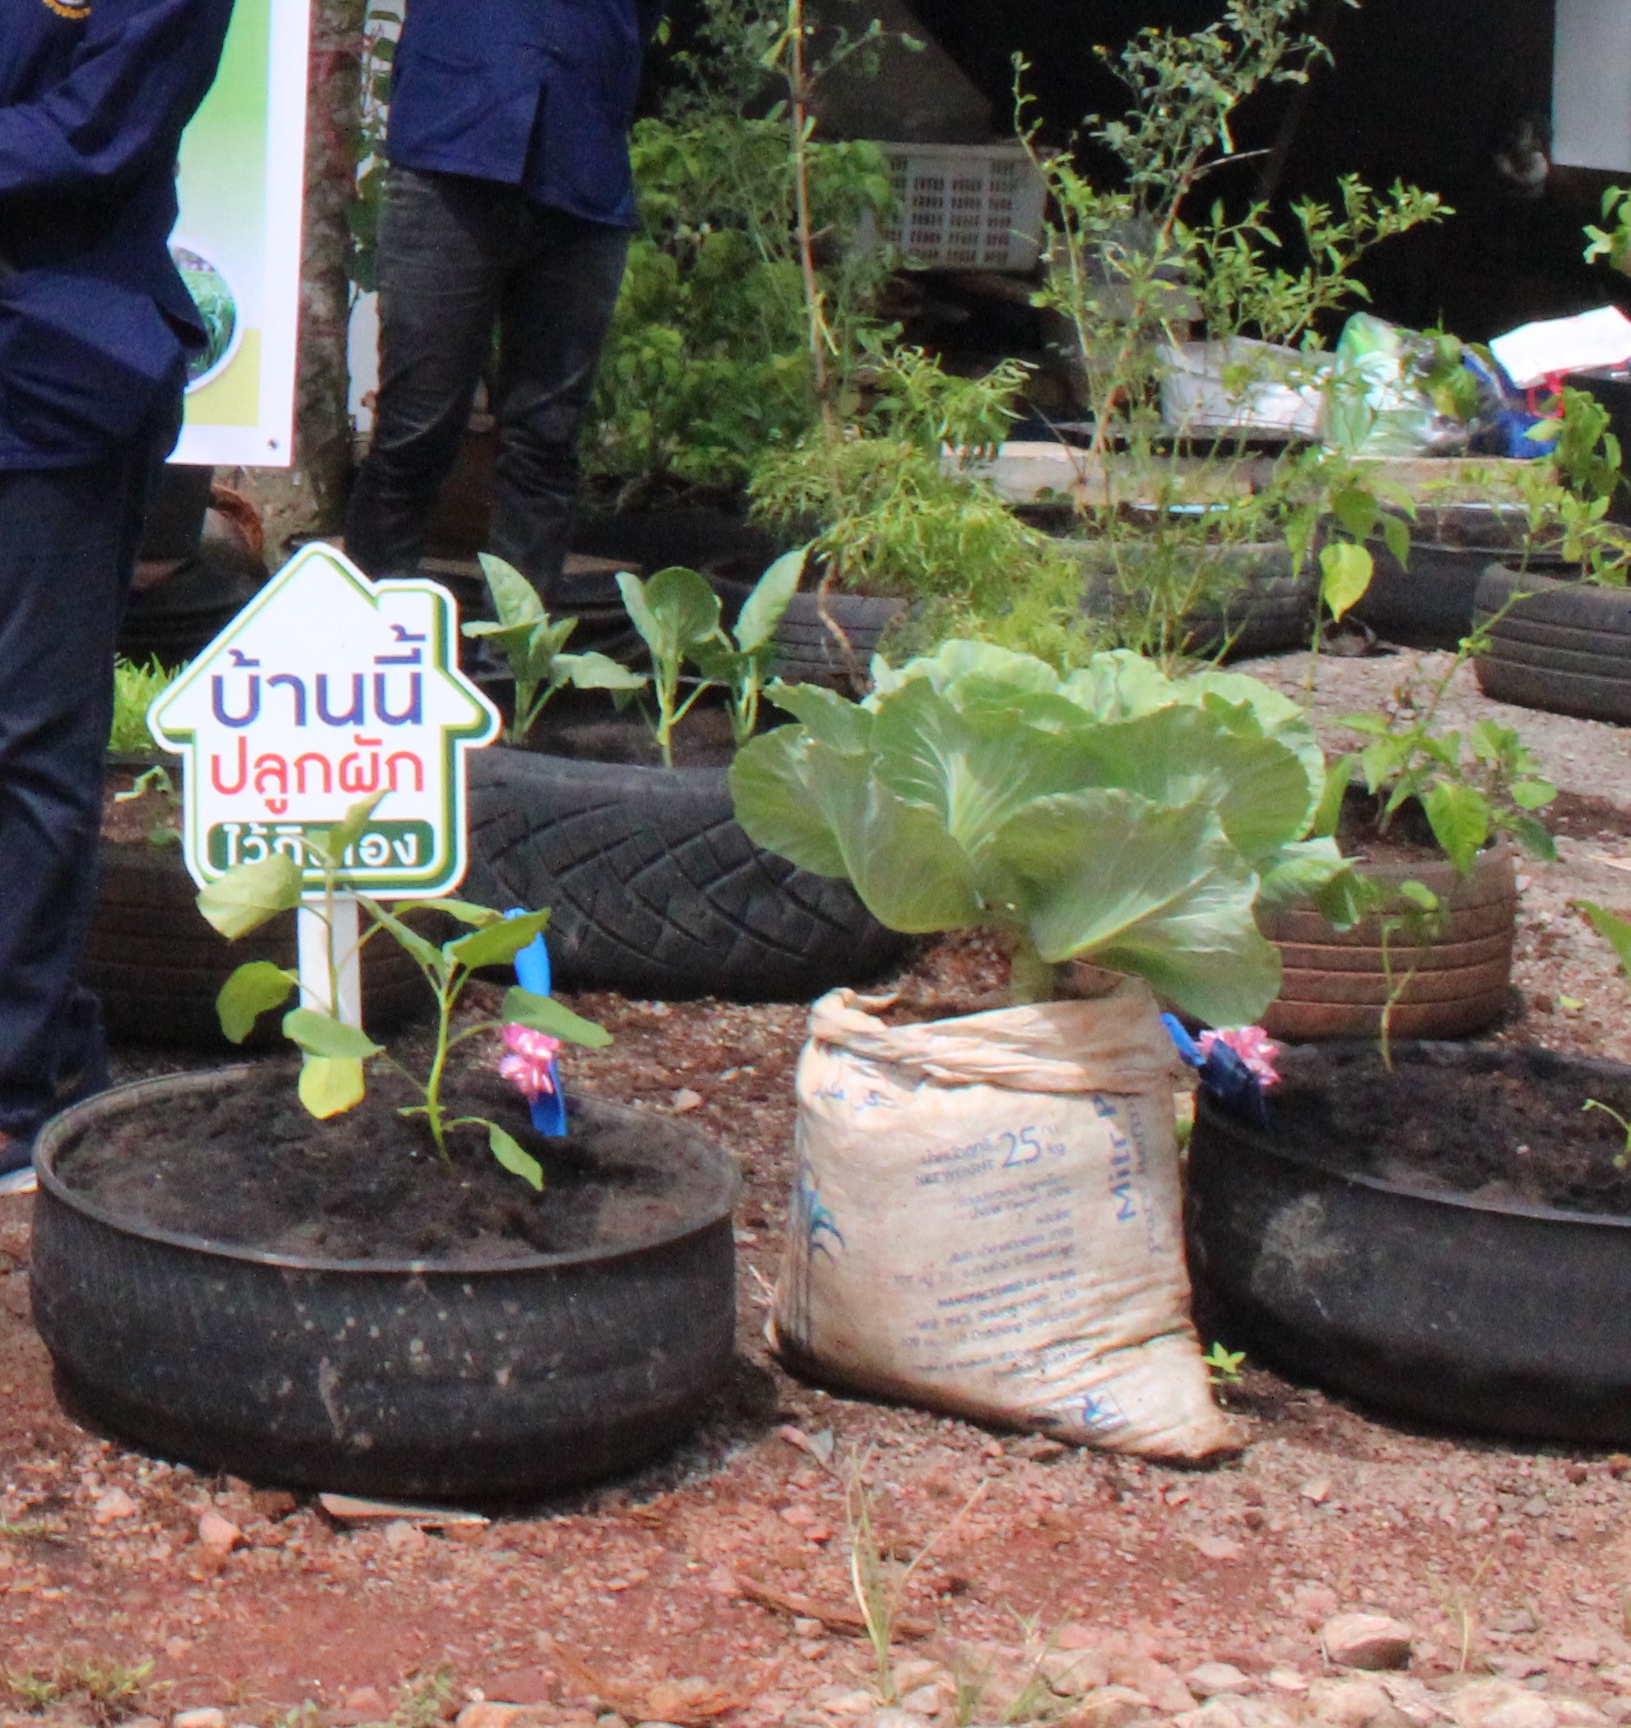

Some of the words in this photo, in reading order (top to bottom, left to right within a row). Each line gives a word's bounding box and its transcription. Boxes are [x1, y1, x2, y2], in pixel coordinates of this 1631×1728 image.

[210, 623, 428, 729] บ้านนี้
[210, 733, 425, 816] ปลูกผัก
[998, 1125, 1041, 1168] 25
